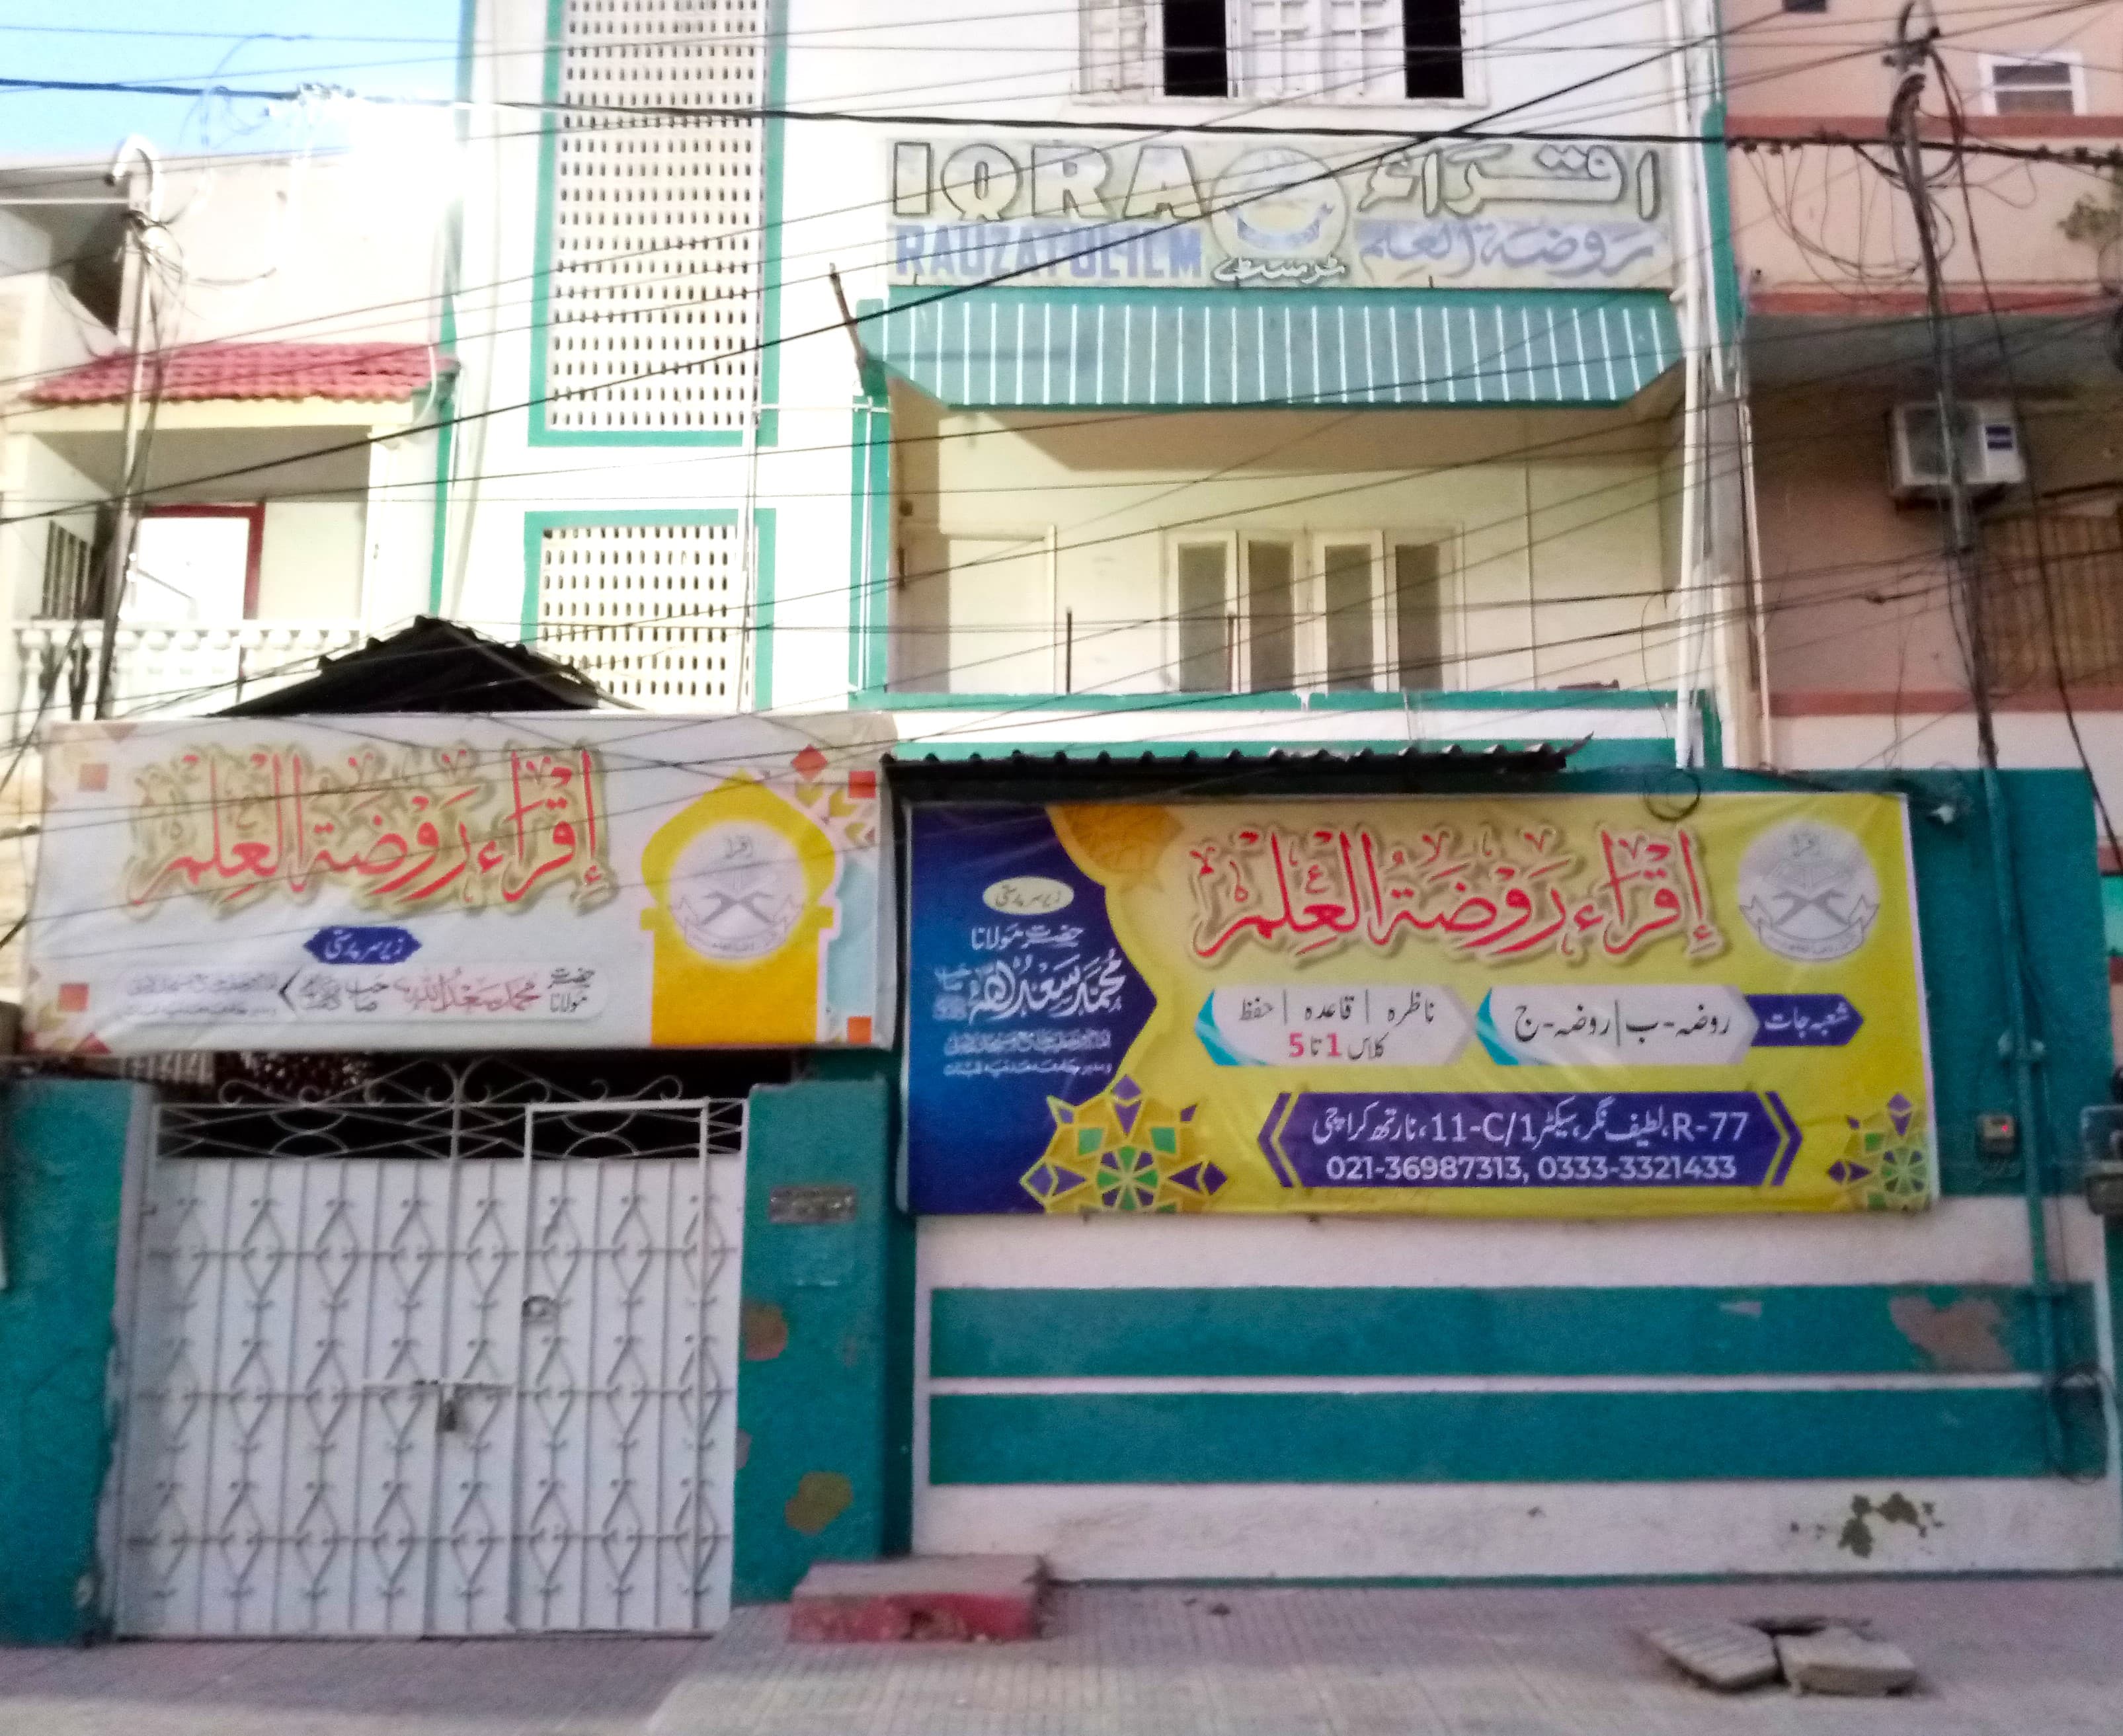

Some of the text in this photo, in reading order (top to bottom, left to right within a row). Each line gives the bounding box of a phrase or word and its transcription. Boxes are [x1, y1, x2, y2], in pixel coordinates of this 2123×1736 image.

[893, 141, 1205, 221] IQRA
[1304, 994, 1355, 1021] قاعدہ
[1387, 988, 1435, 1027] ناظرہ
[1289, 1031, 1304, 1058] 5
[1326, 1032, 1342, 1058] 1
[1325, 1155, 1738, 1185] 021-36987313, 0333-3321433
